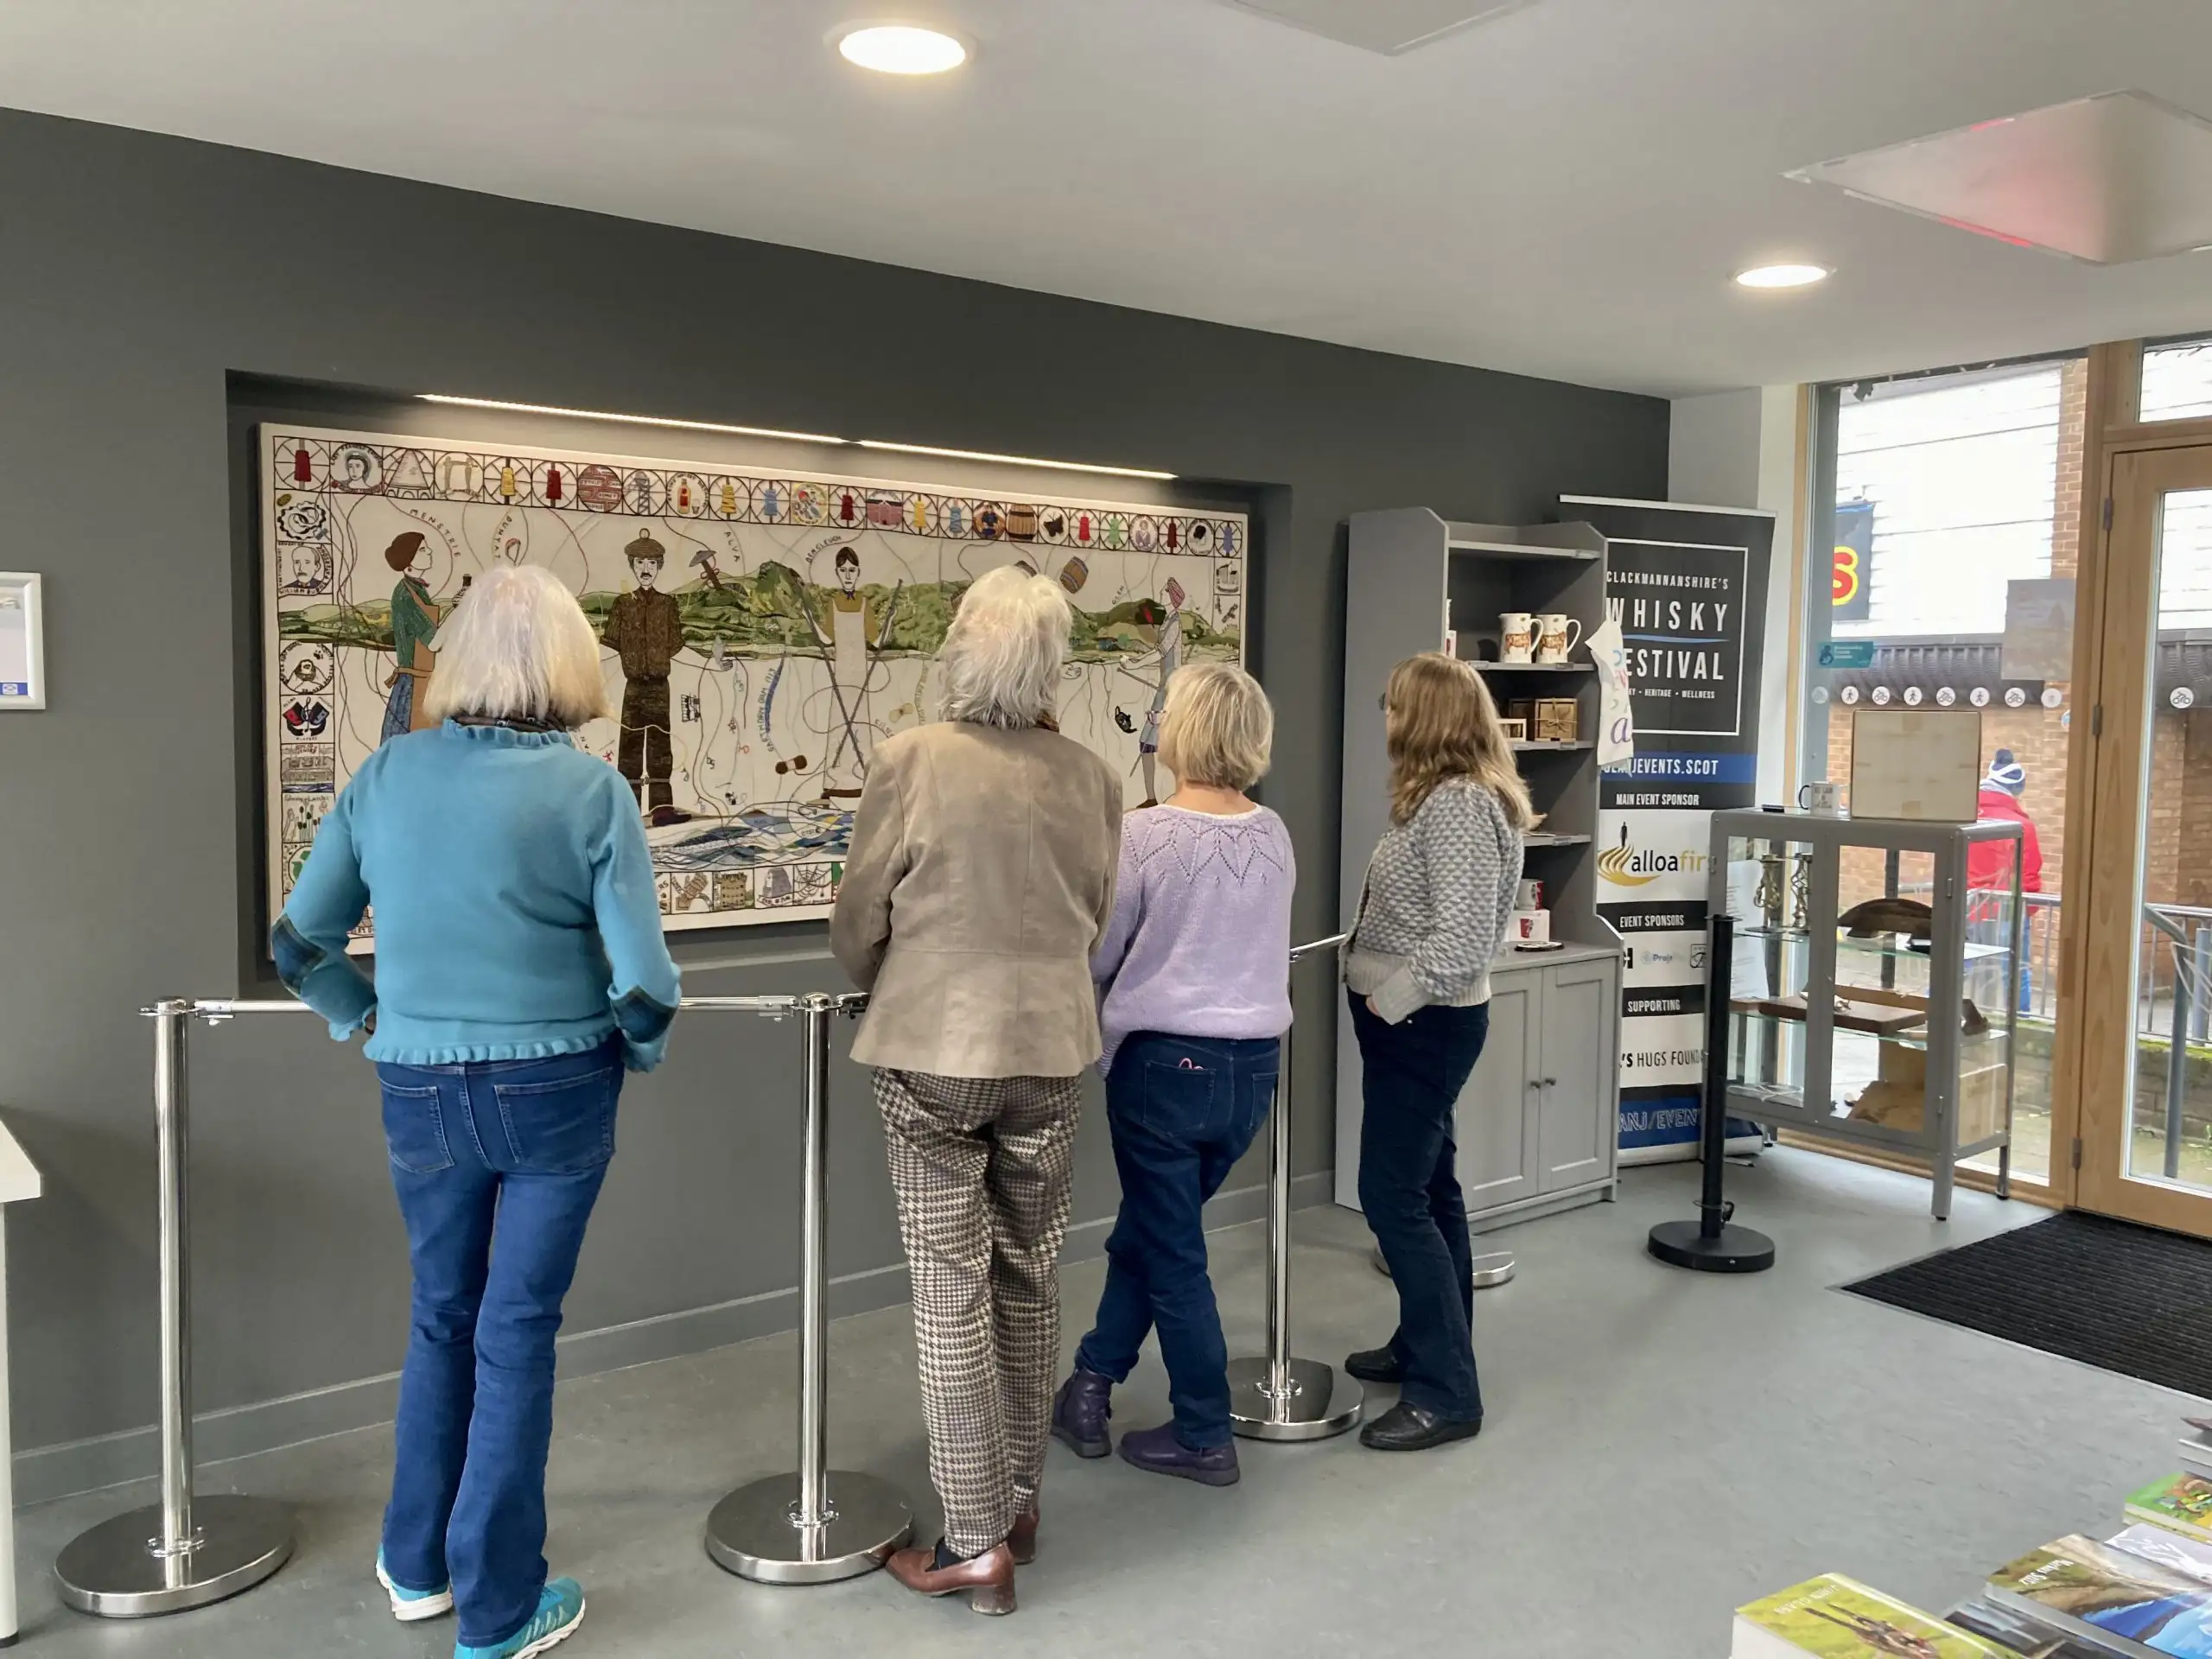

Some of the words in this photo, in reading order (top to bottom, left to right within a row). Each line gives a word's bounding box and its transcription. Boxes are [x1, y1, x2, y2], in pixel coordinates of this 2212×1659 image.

[410, 509, 461, 557] MENSTRIE
[1606, 571, 1728, 589] CLACKMANNANSHIRE'S
[1606, 597, 1728, 632] WHISKY
[1623, 648, 1724, 680] ESTIVAL
[1644, 688, 1672, 697] HERITAGE
[1681, 690, 1715, 699] WELLNESS
[1605, 758, 1719, 775] JEVENTS.SCOT
[1616, 793, 1634, 805] MAIN
[1636, 793, 1660, 805] EVENT
[1662, 793, 1700, 805] SPONSOR
[1631, 849, 1707, 873] alloafir
[1620, 915, 1643, 928] EVENT
[1644, 914, 1685, 927] SPONSORS
[1628, 999, 1681, 1013] SUPPORTING
[1620, 1052, 1633, 1068] 'S
[1637, 1052, 1667, 1067] HUGS
